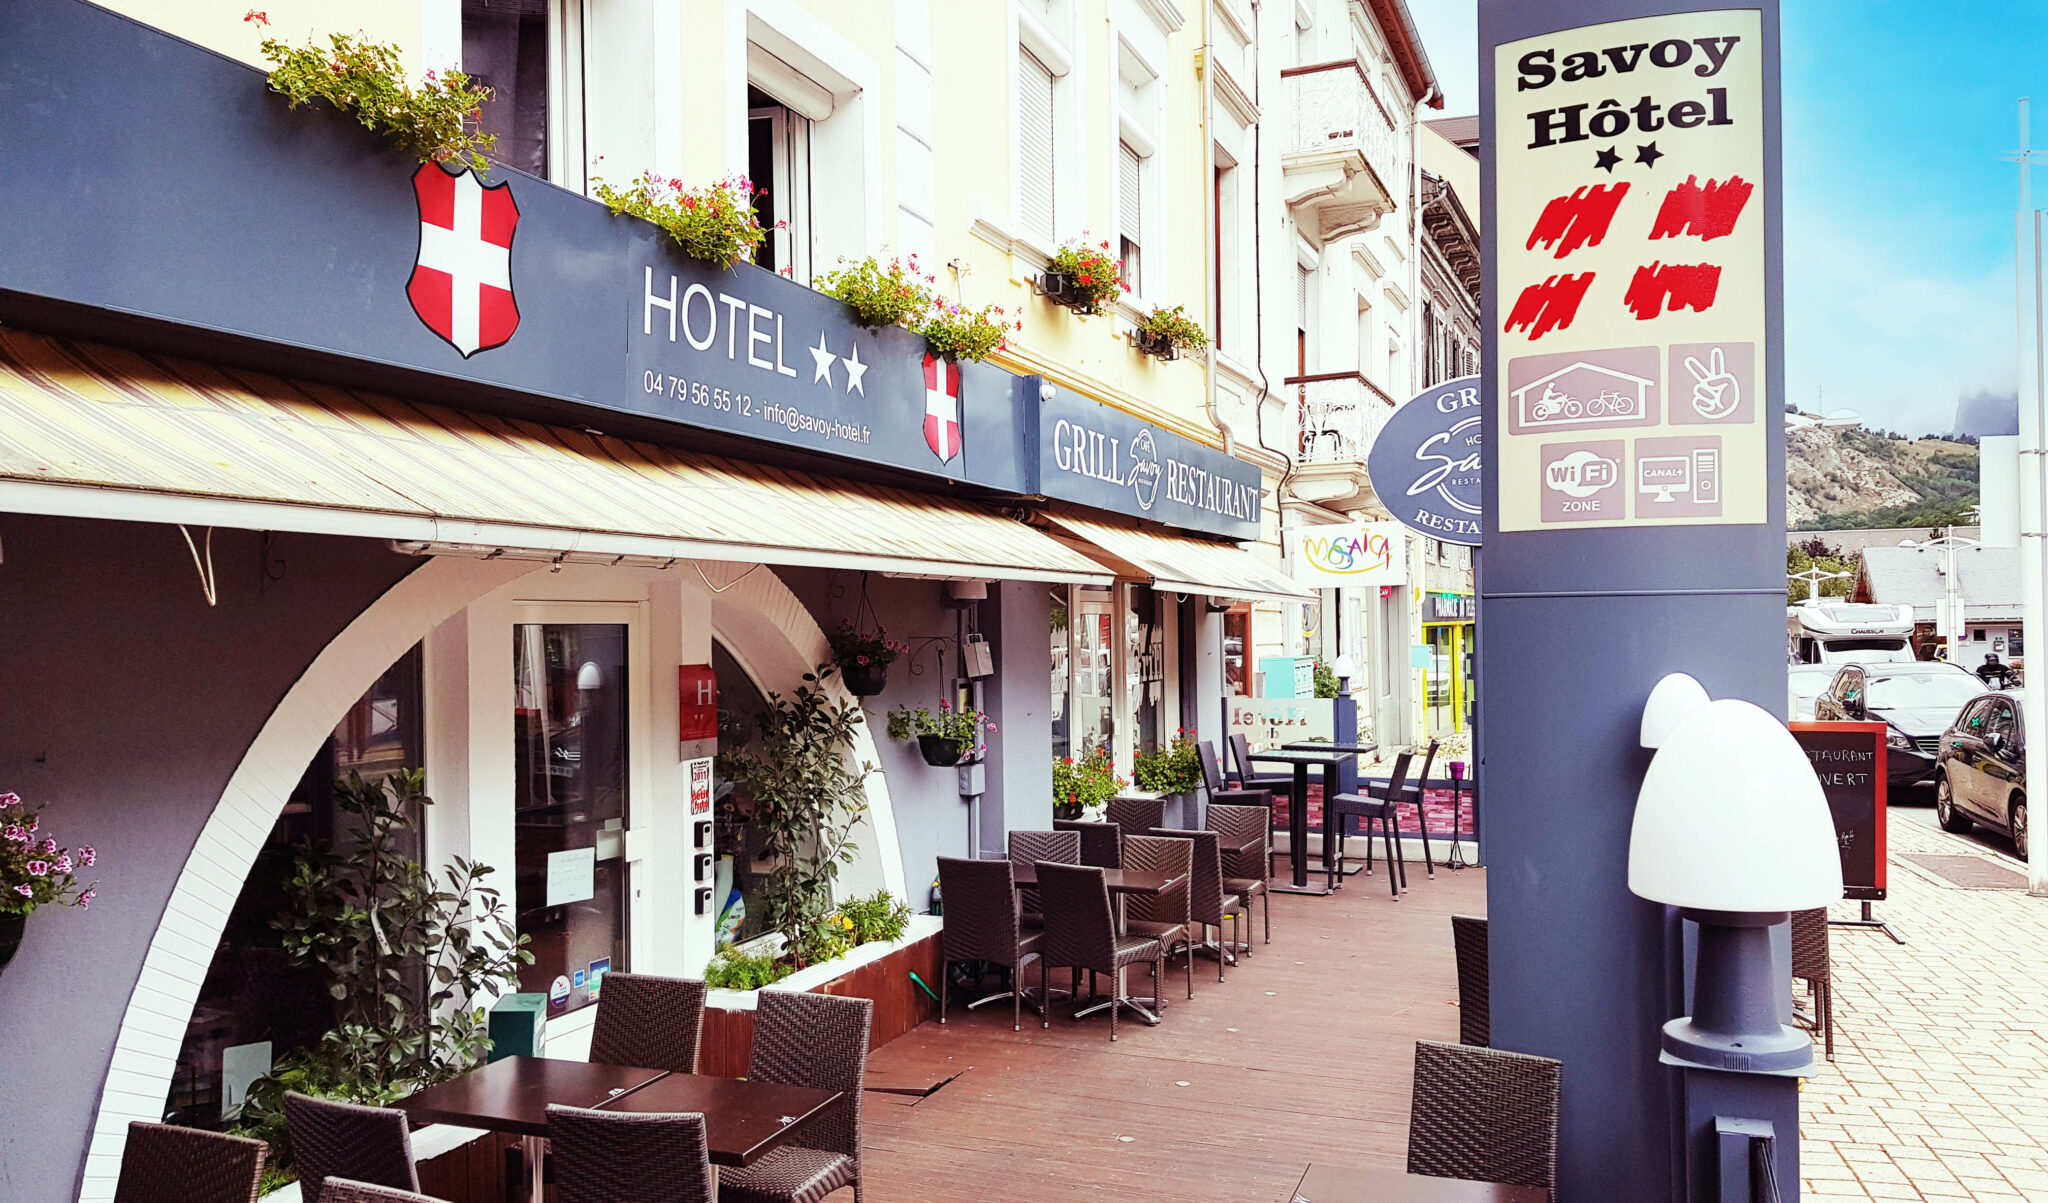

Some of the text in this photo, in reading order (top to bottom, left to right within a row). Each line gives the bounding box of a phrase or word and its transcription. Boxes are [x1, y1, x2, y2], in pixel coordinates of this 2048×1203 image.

[1517, 36, 1741, 92] Savoy
[1526, 87, 1734, 149] Hôtel
[643, 265, 798, 378] HOTEL
[643, 369, 664, 396] 04
[668, 376, 687, 401] 79
[691, 382, 710, 407] 56
[713, 388, 731, 412] 55
[735, 393, 752, 417] 12
[763, 400, 871, 445] info@savoy-hotel.fr
[1053, 418, 1125, 487] GRILL
[1643, 468, 1684, 478] CANAL+
[1165, 458, 1260, 523] RESTAURANT
[1561, 501, 1601, 513] ZONE
[696, 679, 714, 706] H
